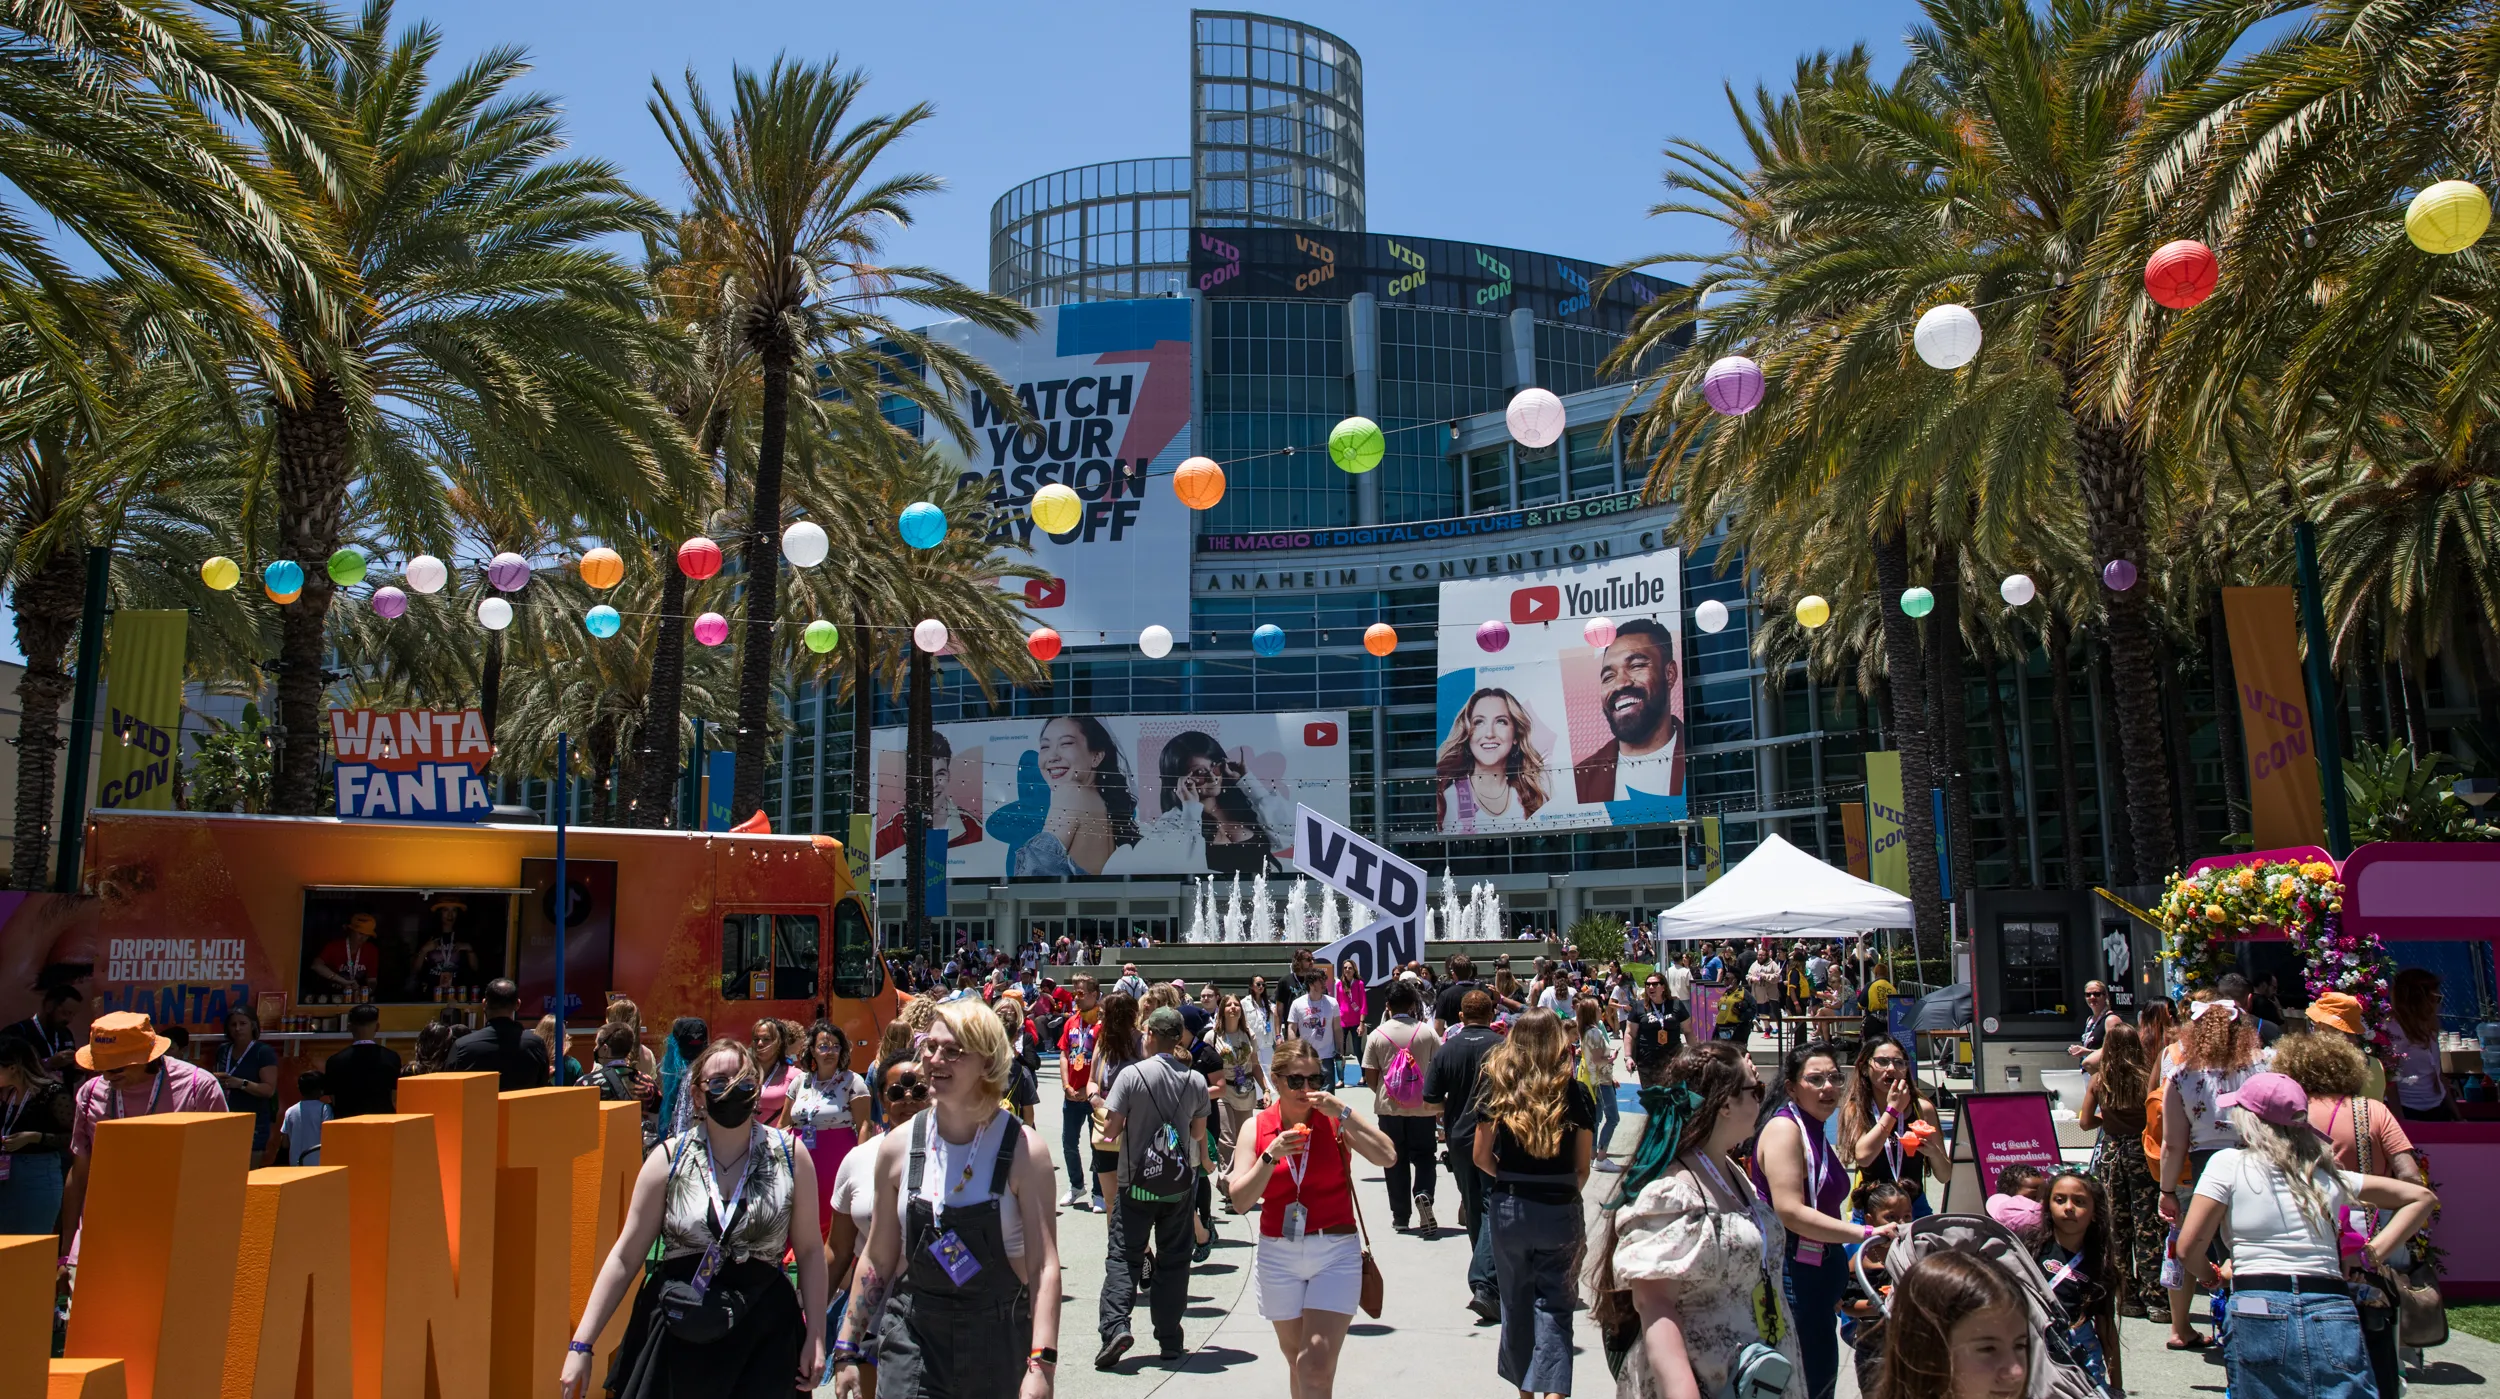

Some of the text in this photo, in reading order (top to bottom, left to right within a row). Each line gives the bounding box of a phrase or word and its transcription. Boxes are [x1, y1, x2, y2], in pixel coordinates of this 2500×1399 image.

[1200, 232, 1240, 262] VID
[1295, 233, 1334, 264] VID
[1388, 239, 1425, 270] VID
[1200, 261, 1240, 291] CON
[1296, 263, 1335, 292] CON
[1475, 248, 1511, 280] VID
[1556, 260, 1590, 293] VID
[1388, 269, 1426, 297] CON
[1476, 279, 1512, 305] CON
[1558, 292, 1591, 317] CON
[970, 374, 1133, 429] WATCH
[987, 418, 1114, 467] YOUR
[957, 457, 1149, 507] PASSION
[1208, 535, 1230, 550] THE
[1234, 534, 1311, 550] MAGIC
[1314, 532, 1330, 547] OF
[1333, 526, 1419, 545] DIGITAL
[1423, 513, 1524, 538] CULTURE
[1526, 511, 1544, 527] &
[1546, 505, 1582, 523] ITS
[1207, 568, 1357, 591] ANAHEIM
[1388, 539, 1610, 583] CONVENTION
[1564, 571, 1664, 617] YouTube
[2243, 683, 2303, 730] VID
[112, 706, 171, 758] VID
[332, 711, 490, 760] WANTA
[2254, 728, 2308, 780] CON
[101, 757, 170, 809] CON
[337, 764, 490, 817] FANTA
[711, 801, 733, 825] VI
[850, 846, 870, 863] VID
[927, 857, 945, 873] VID
[1306, 815, 1419, 918] VID
[1706, 844, 1719, 859] VID
[1706, 859, 1719, 872] CON
[850, 862, 870, 879] CON
[927, 873, 945, 887] CON
[109, 939, 246, 960] DRIPPING WITH
[1314, 917, 1417, 987] ON
[108, 960, 245, 981] DELICIOUSNESS
[1146, 1147, 1164, 1165] VID
[1991, 1141, 2007, 1151] tag
[1143, 1163, 1163, 1177] CON
